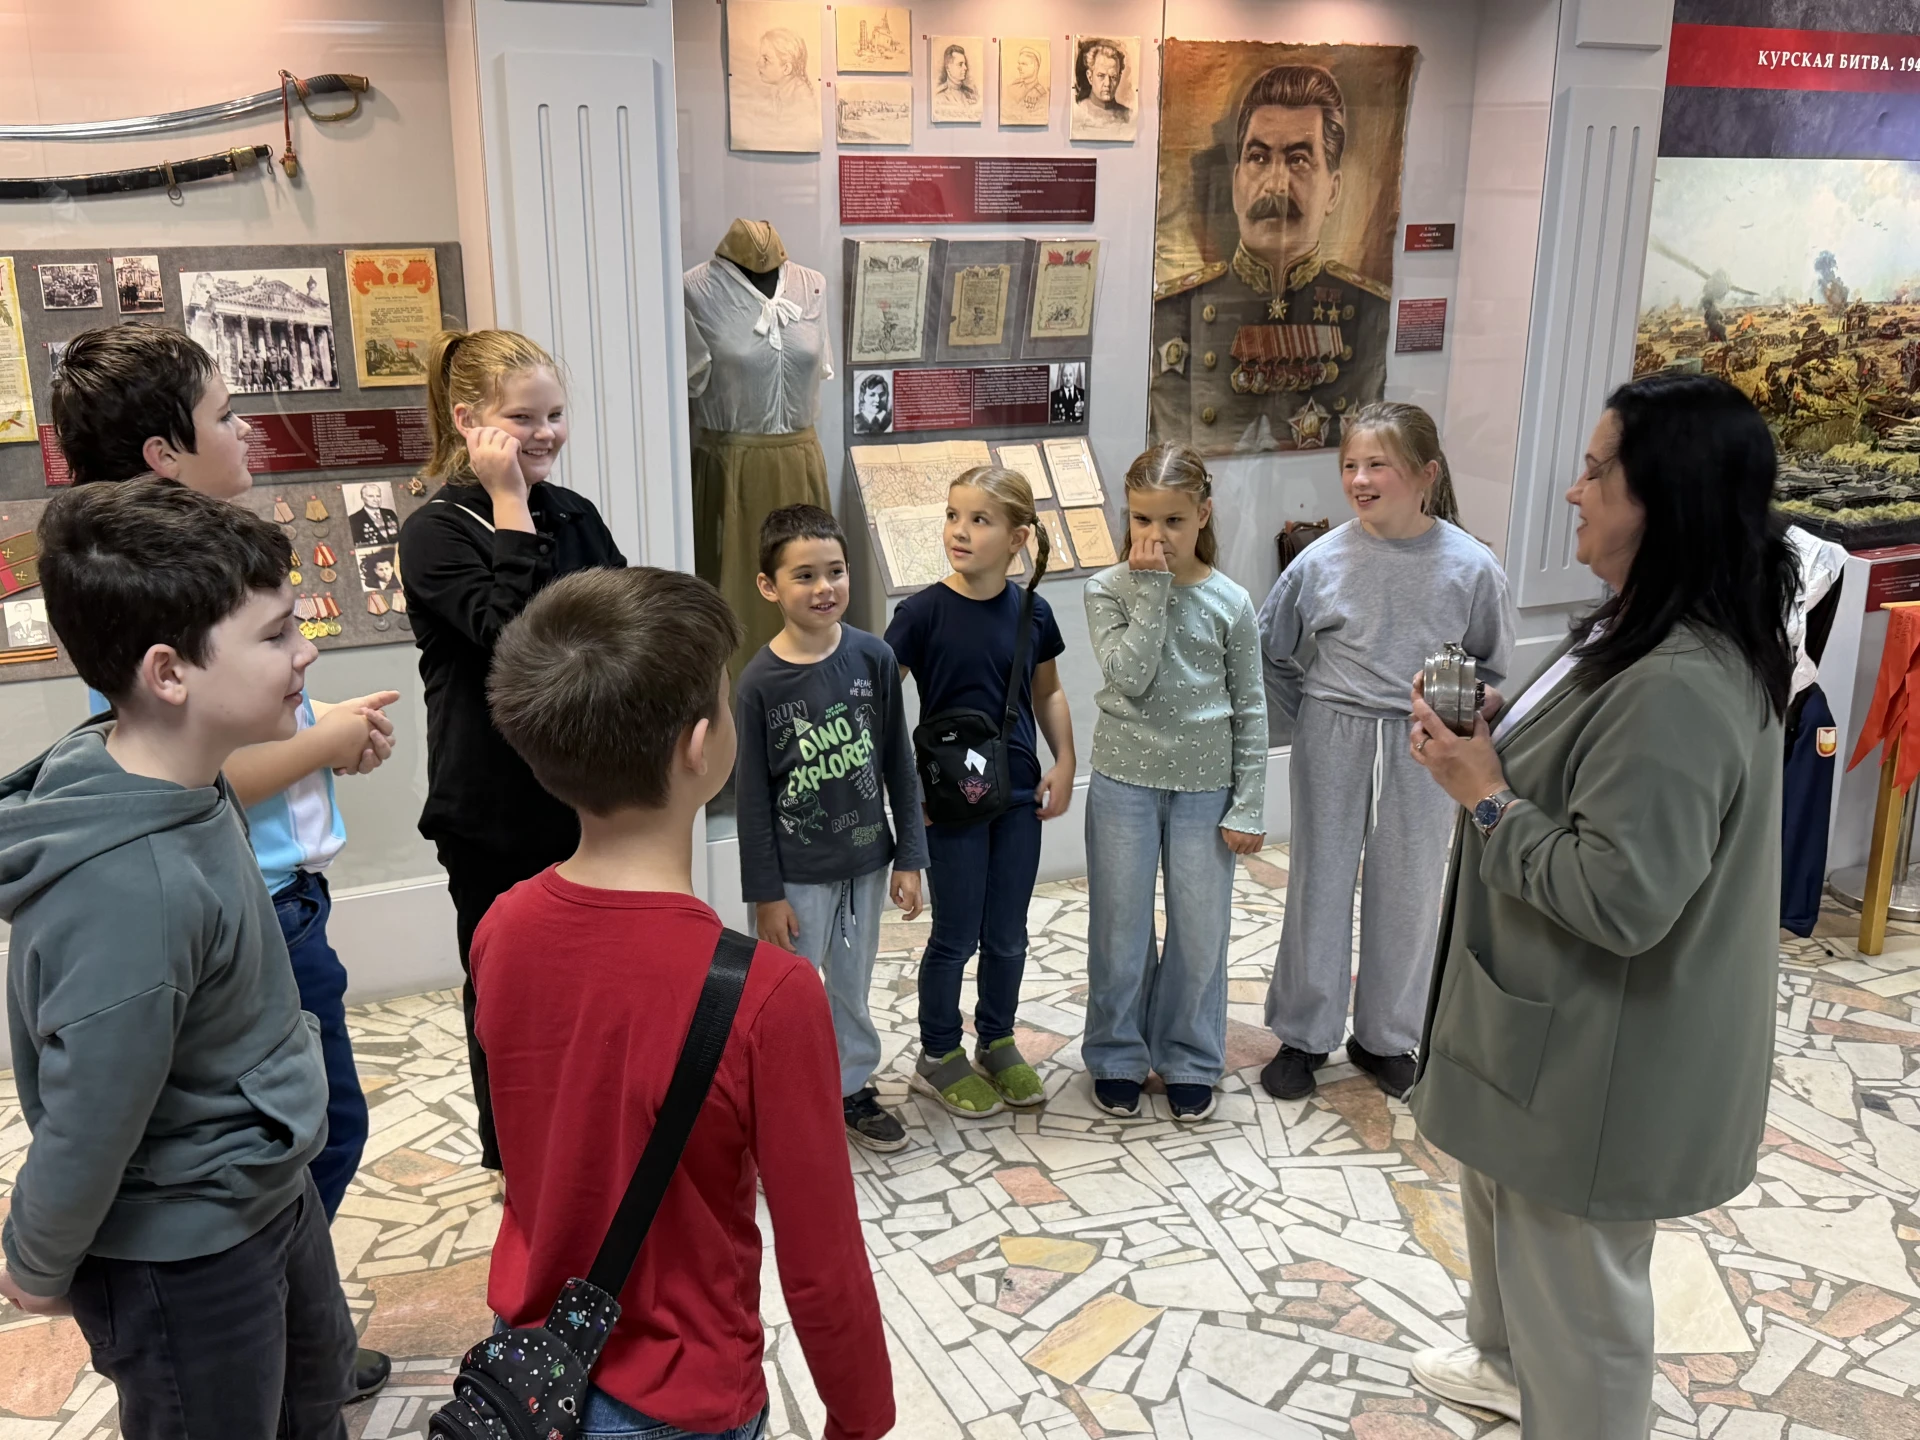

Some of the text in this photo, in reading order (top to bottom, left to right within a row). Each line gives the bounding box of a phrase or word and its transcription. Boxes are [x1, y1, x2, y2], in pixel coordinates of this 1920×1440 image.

[1757, 50, 1834, 69] КУРСКАЯ
[1839, 53, 1895, 71] БИТВА.
[768, 699, 809, 730] RUN
[799, 716, 853, 762] DINO
[787, 728, 875, 797] EXPLORER
[831, 810, 859, 834] RUN
